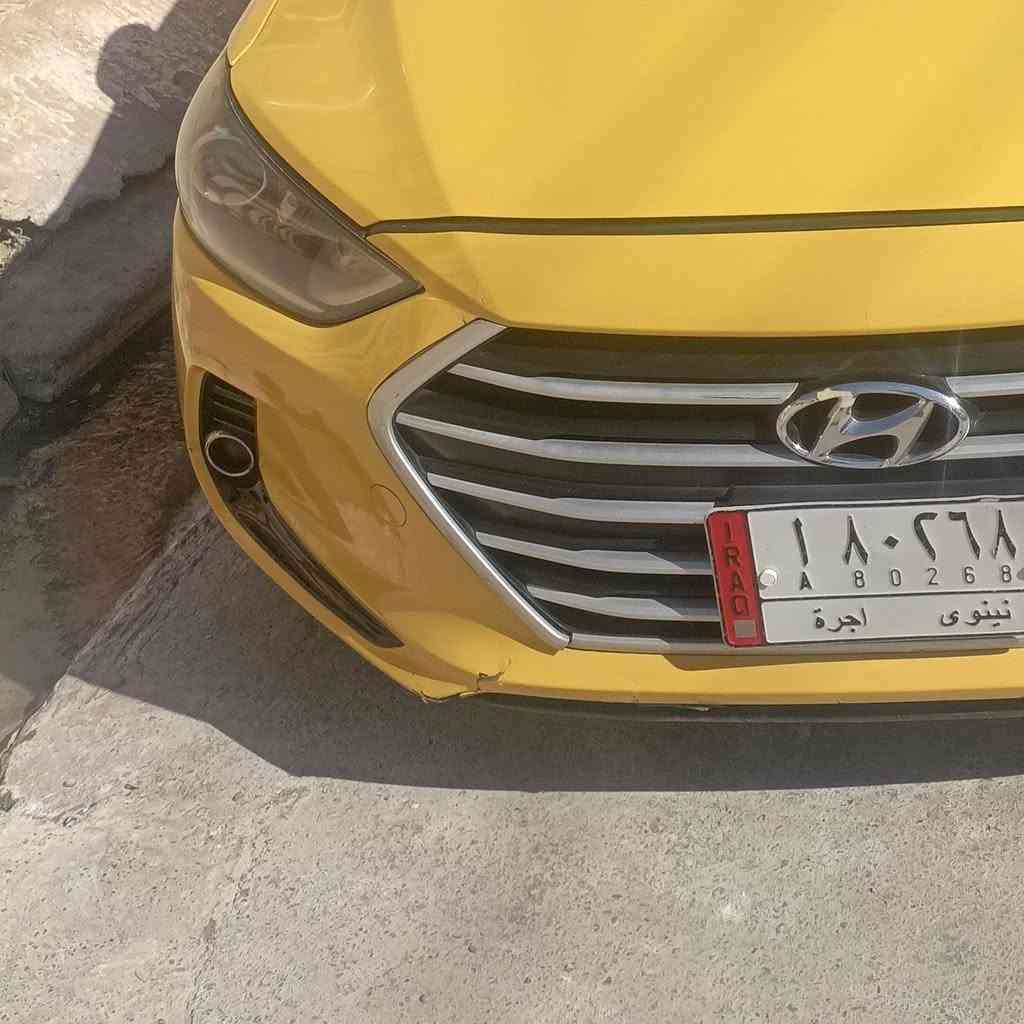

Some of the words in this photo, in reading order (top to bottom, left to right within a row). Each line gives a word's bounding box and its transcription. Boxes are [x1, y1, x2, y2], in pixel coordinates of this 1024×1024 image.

[722, 521, 750, 617] IRAQ
[799, 571, 813, 591] A
[939, 599, 1013, 628] نينوى
